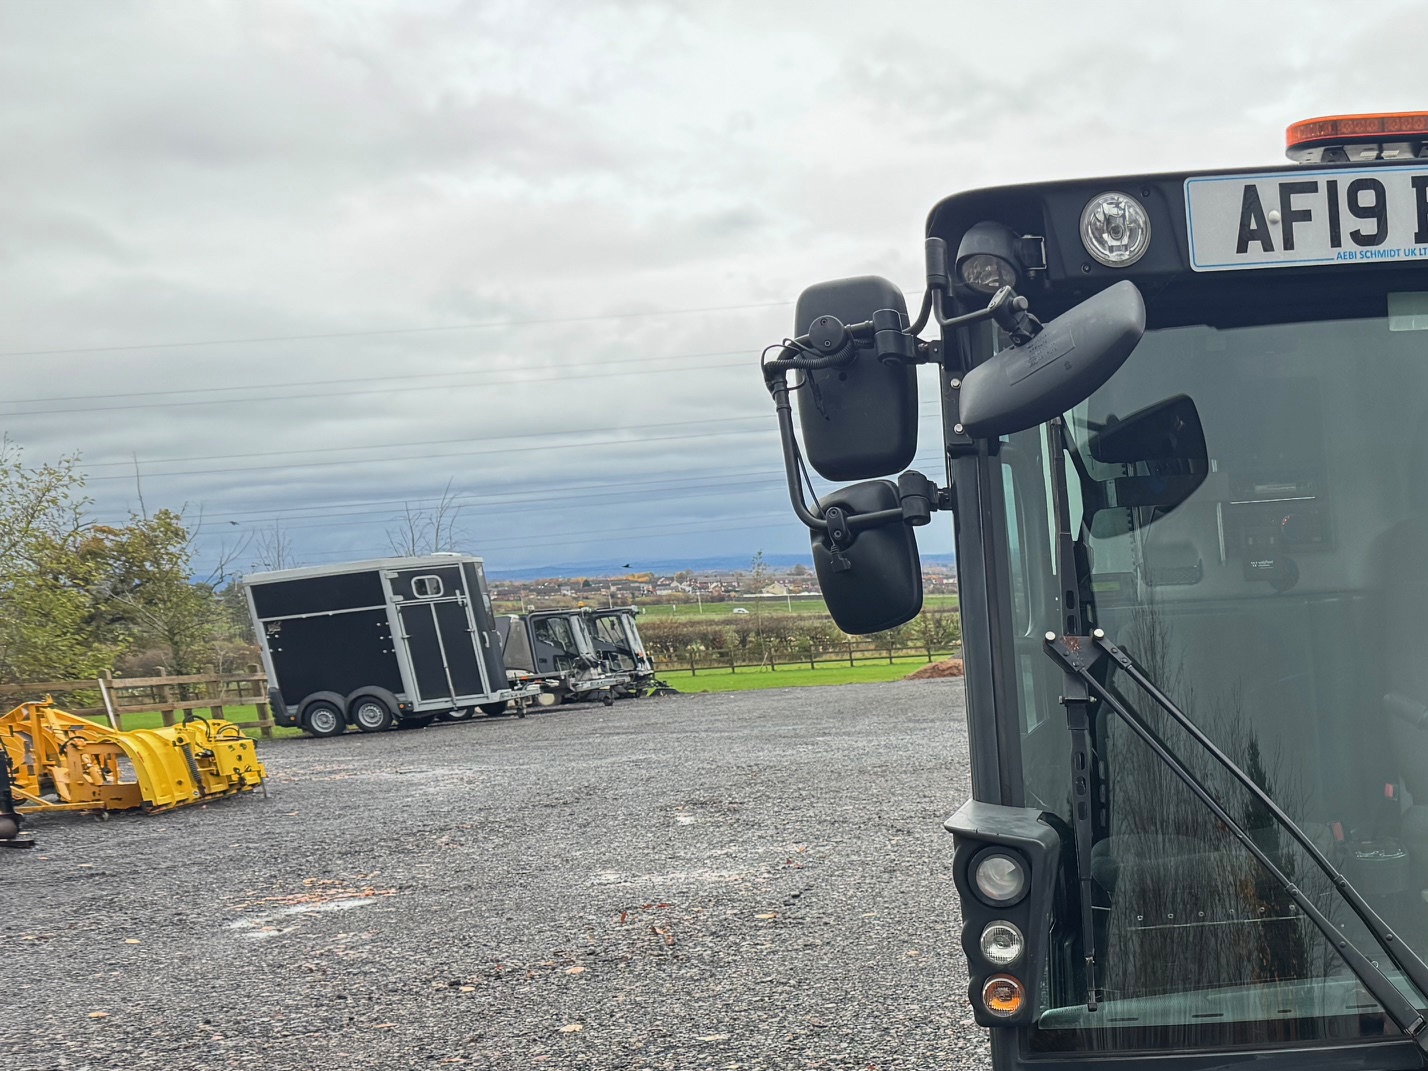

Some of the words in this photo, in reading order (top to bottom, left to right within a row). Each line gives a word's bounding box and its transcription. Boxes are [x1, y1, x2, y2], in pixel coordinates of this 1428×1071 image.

[1236, 177, 1389, 255] AF19
[1336, 251, 1357, 260] AEBI
[1359, 248, 1401, 259] SCHMIDT
[1403, 248, 1417, 257] UK
